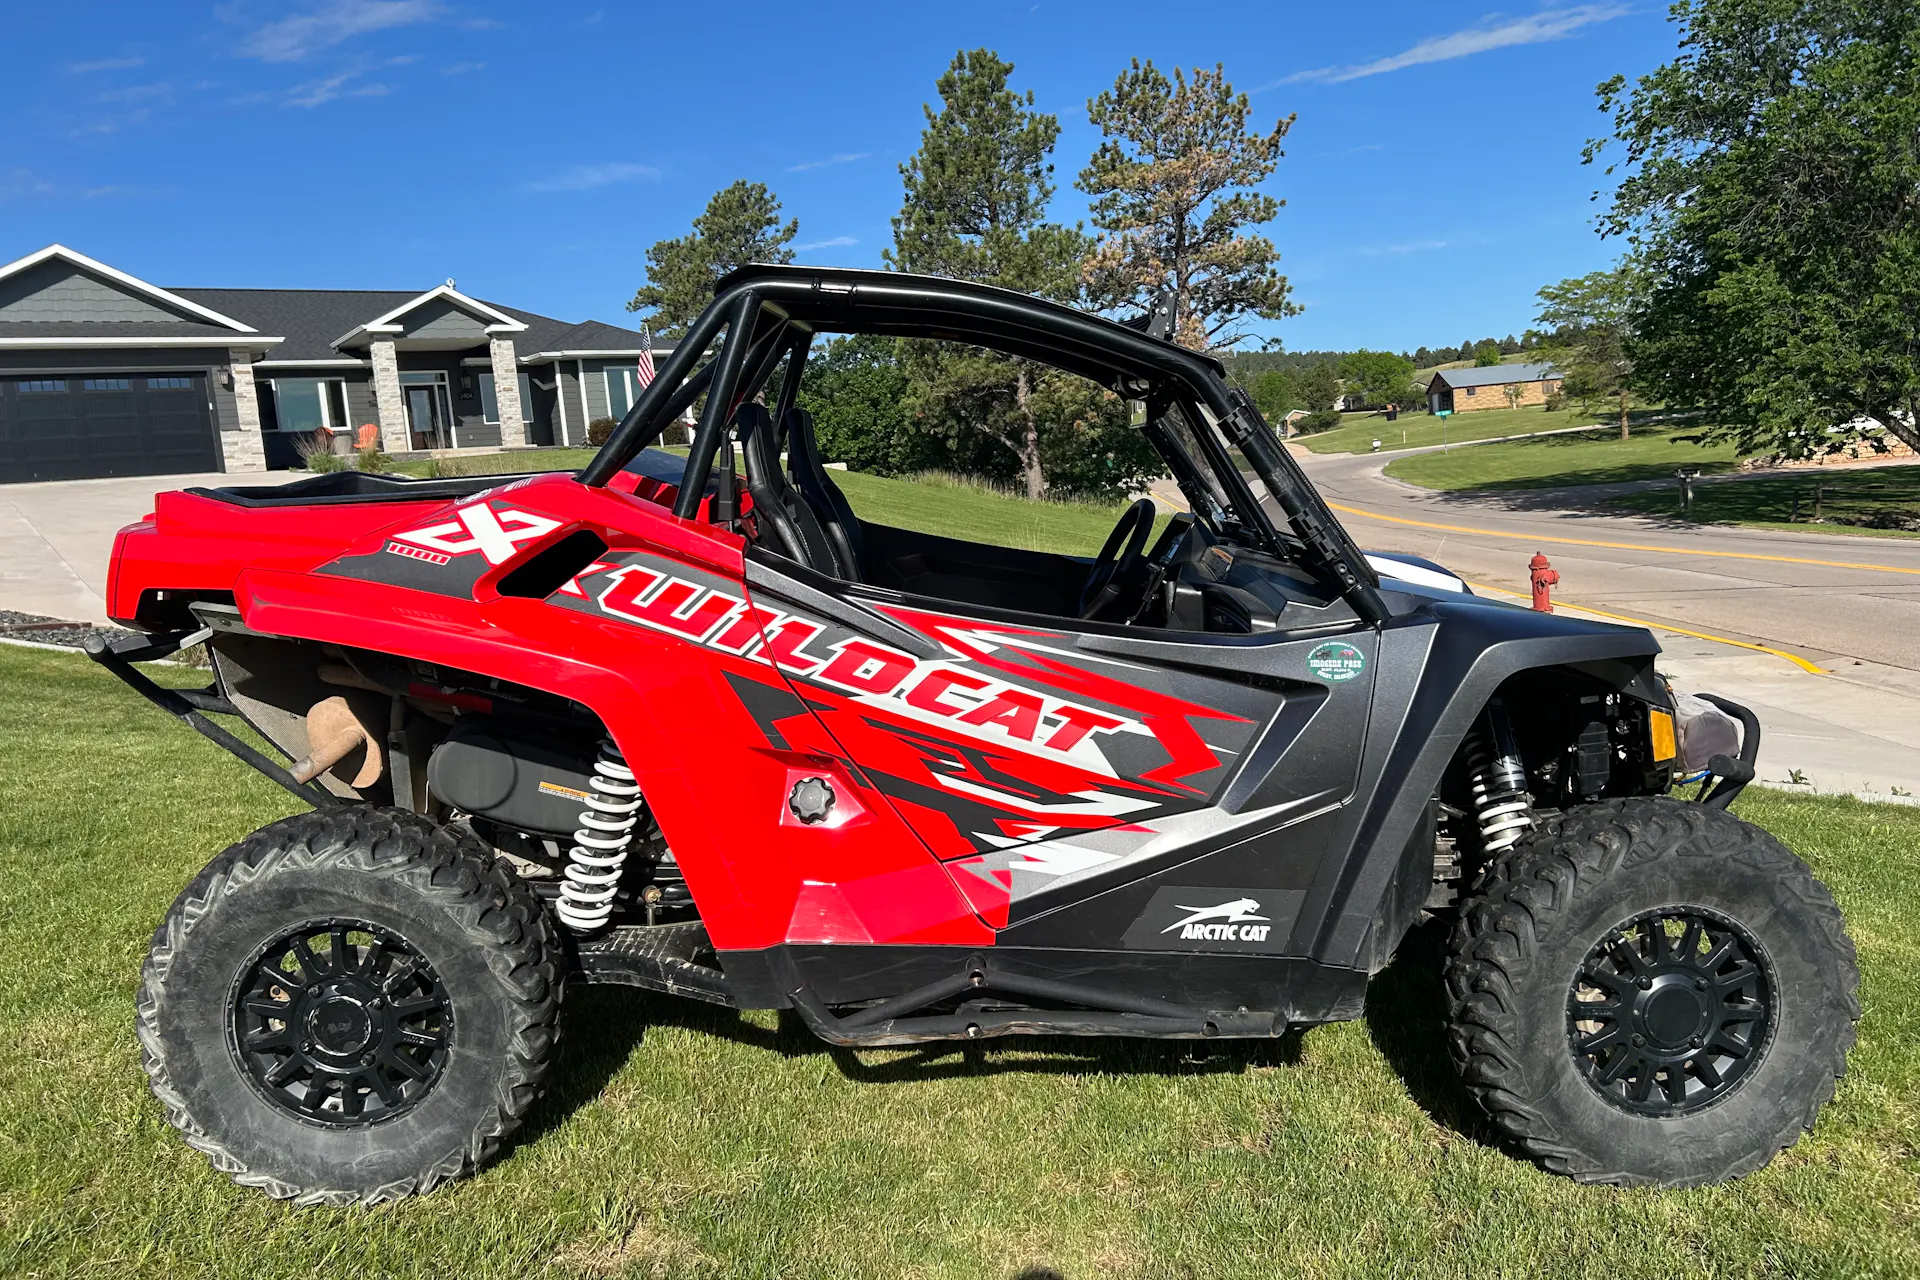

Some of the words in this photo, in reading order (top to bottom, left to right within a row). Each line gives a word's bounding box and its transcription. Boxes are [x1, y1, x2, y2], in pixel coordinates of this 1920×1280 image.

[386, 542, 452, 566] 1000
[597, 564, 1131, 752] WILDCAT
[1180, 924, 1239, 940] ARCTIC
[1239, 925, 1271, 942] CAT
